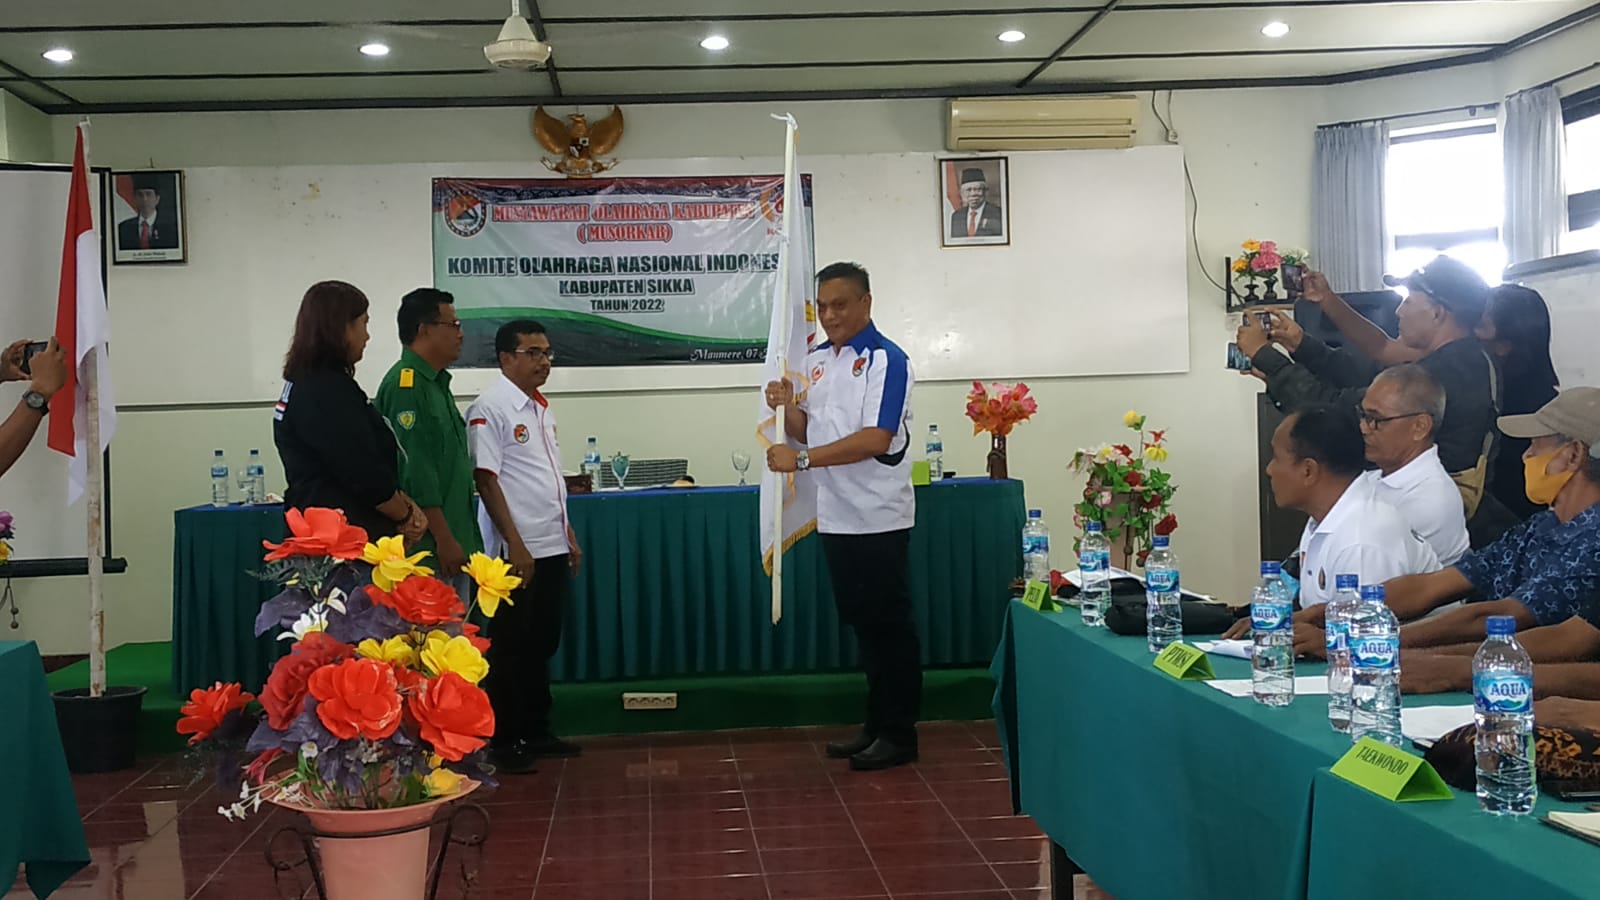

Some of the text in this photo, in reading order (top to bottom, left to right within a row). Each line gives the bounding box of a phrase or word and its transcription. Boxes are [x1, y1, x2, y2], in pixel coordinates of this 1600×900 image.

[492, 203, 590, 222] MUSYAWARAH
[592, 202, 670, 221] OLAHRAGA
[448, 252, 780, 276] KOMITE OLAHRAGA NASIONAL INDONES
[559, 278, 695, 296] KABUPATEN SIKKA
[590, 299, 665, 313] TAHUN 2022
[745, 348, 759, 359] 07
[1253, 608, 1278, 619] AQUA
[1360, 642, 1393, 654] AQUA
[1490, 682, 1527, 696] AQUA
[1356, 745, 1409, 776] TAEKWONDO
